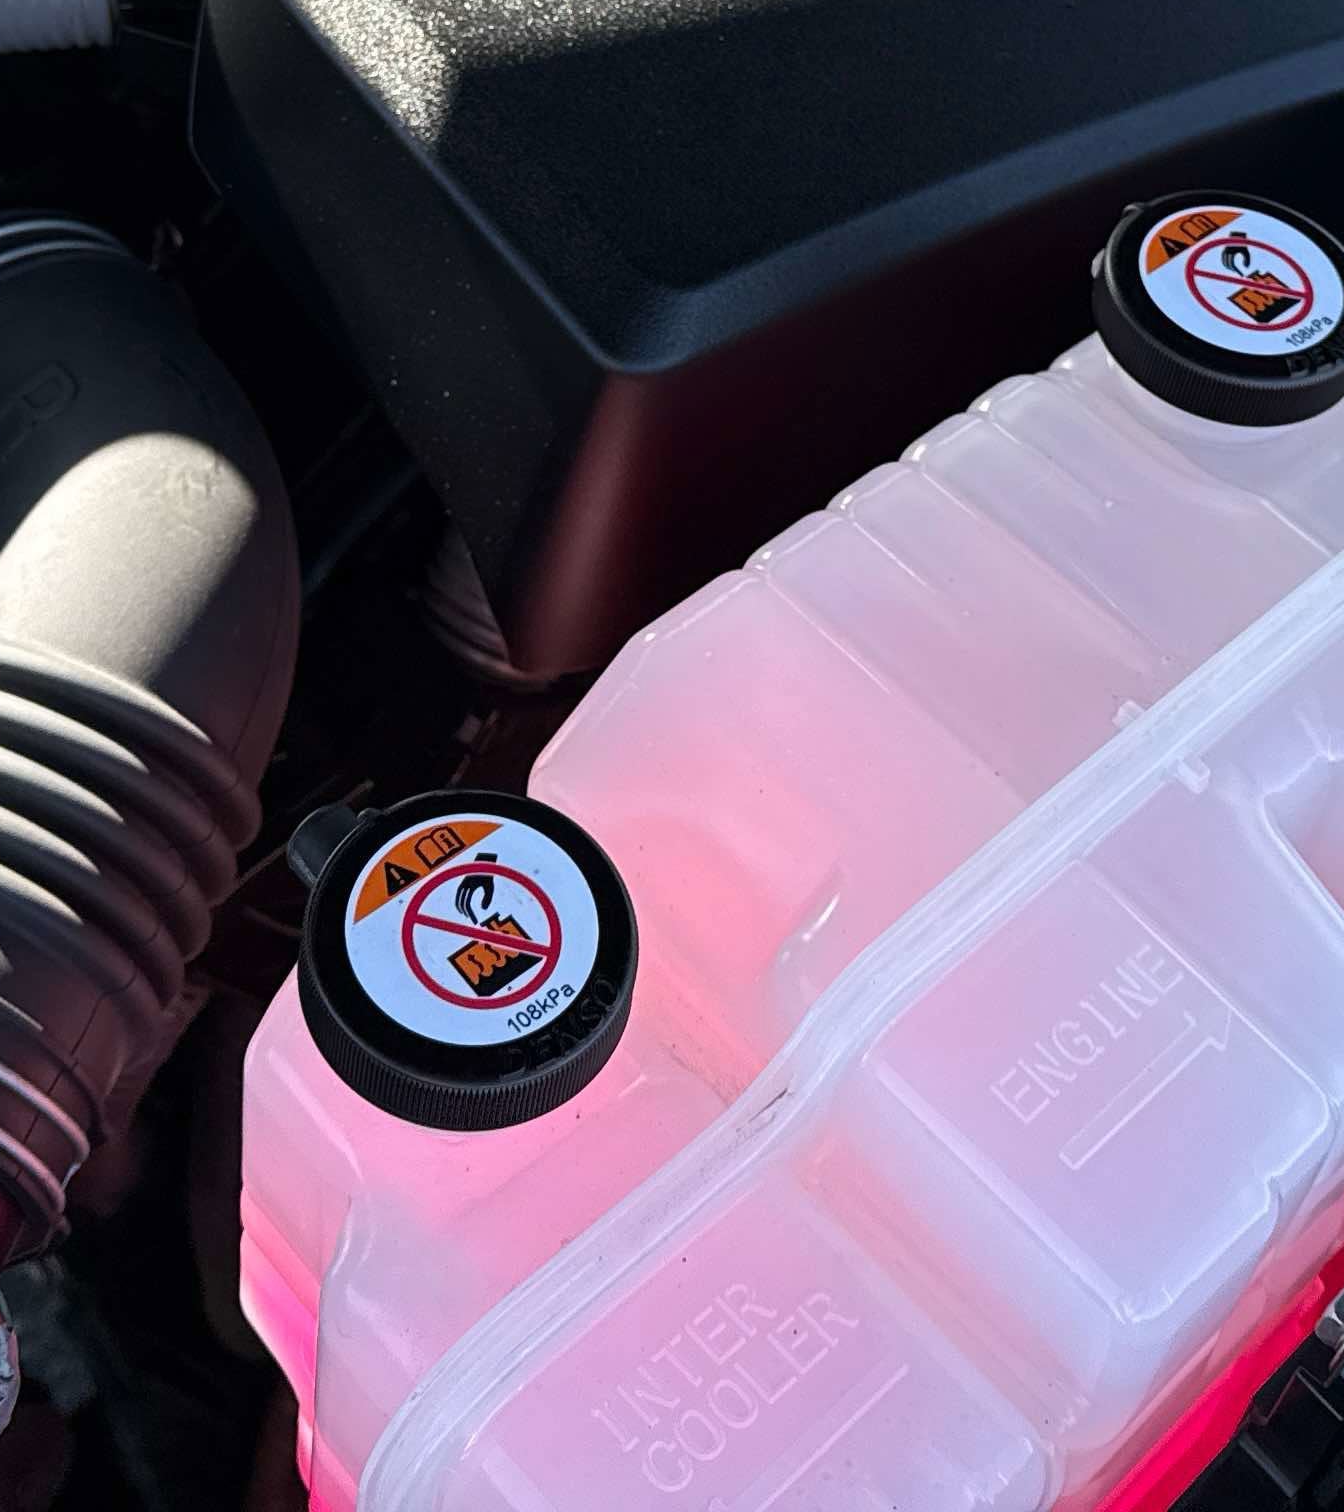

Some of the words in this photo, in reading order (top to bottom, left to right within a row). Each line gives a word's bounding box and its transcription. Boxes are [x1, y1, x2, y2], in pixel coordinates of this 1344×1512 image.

[1286, 316, 1333, 346] 108kPa
[507, 984, 575, 1033] 108kPa
[989, 944, 1184, 1124] ENGINE
[590, 1284, 777, 1453] INTER
[642, 1293, 859, 1493] COOLER
